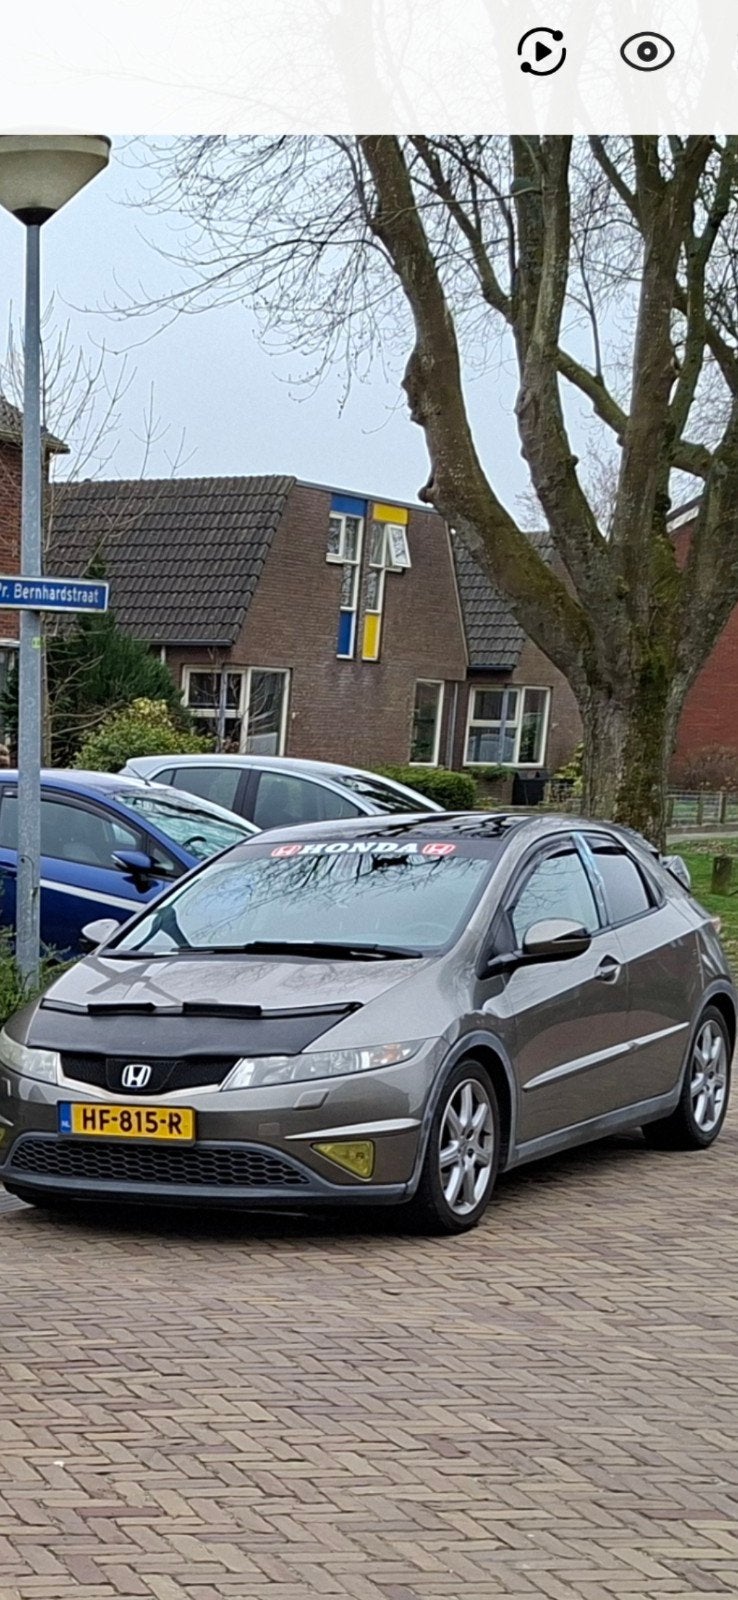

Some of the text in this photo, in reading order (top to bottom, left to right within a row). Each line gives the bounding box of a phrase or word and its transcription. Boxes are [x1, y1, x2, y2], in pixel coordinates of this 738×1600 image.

[0, 582, 99, 604] r. Bernhardstraat
[298, 842, 418, 855] HONDA
[82, 1108, 182, 1135] HF-815-R
